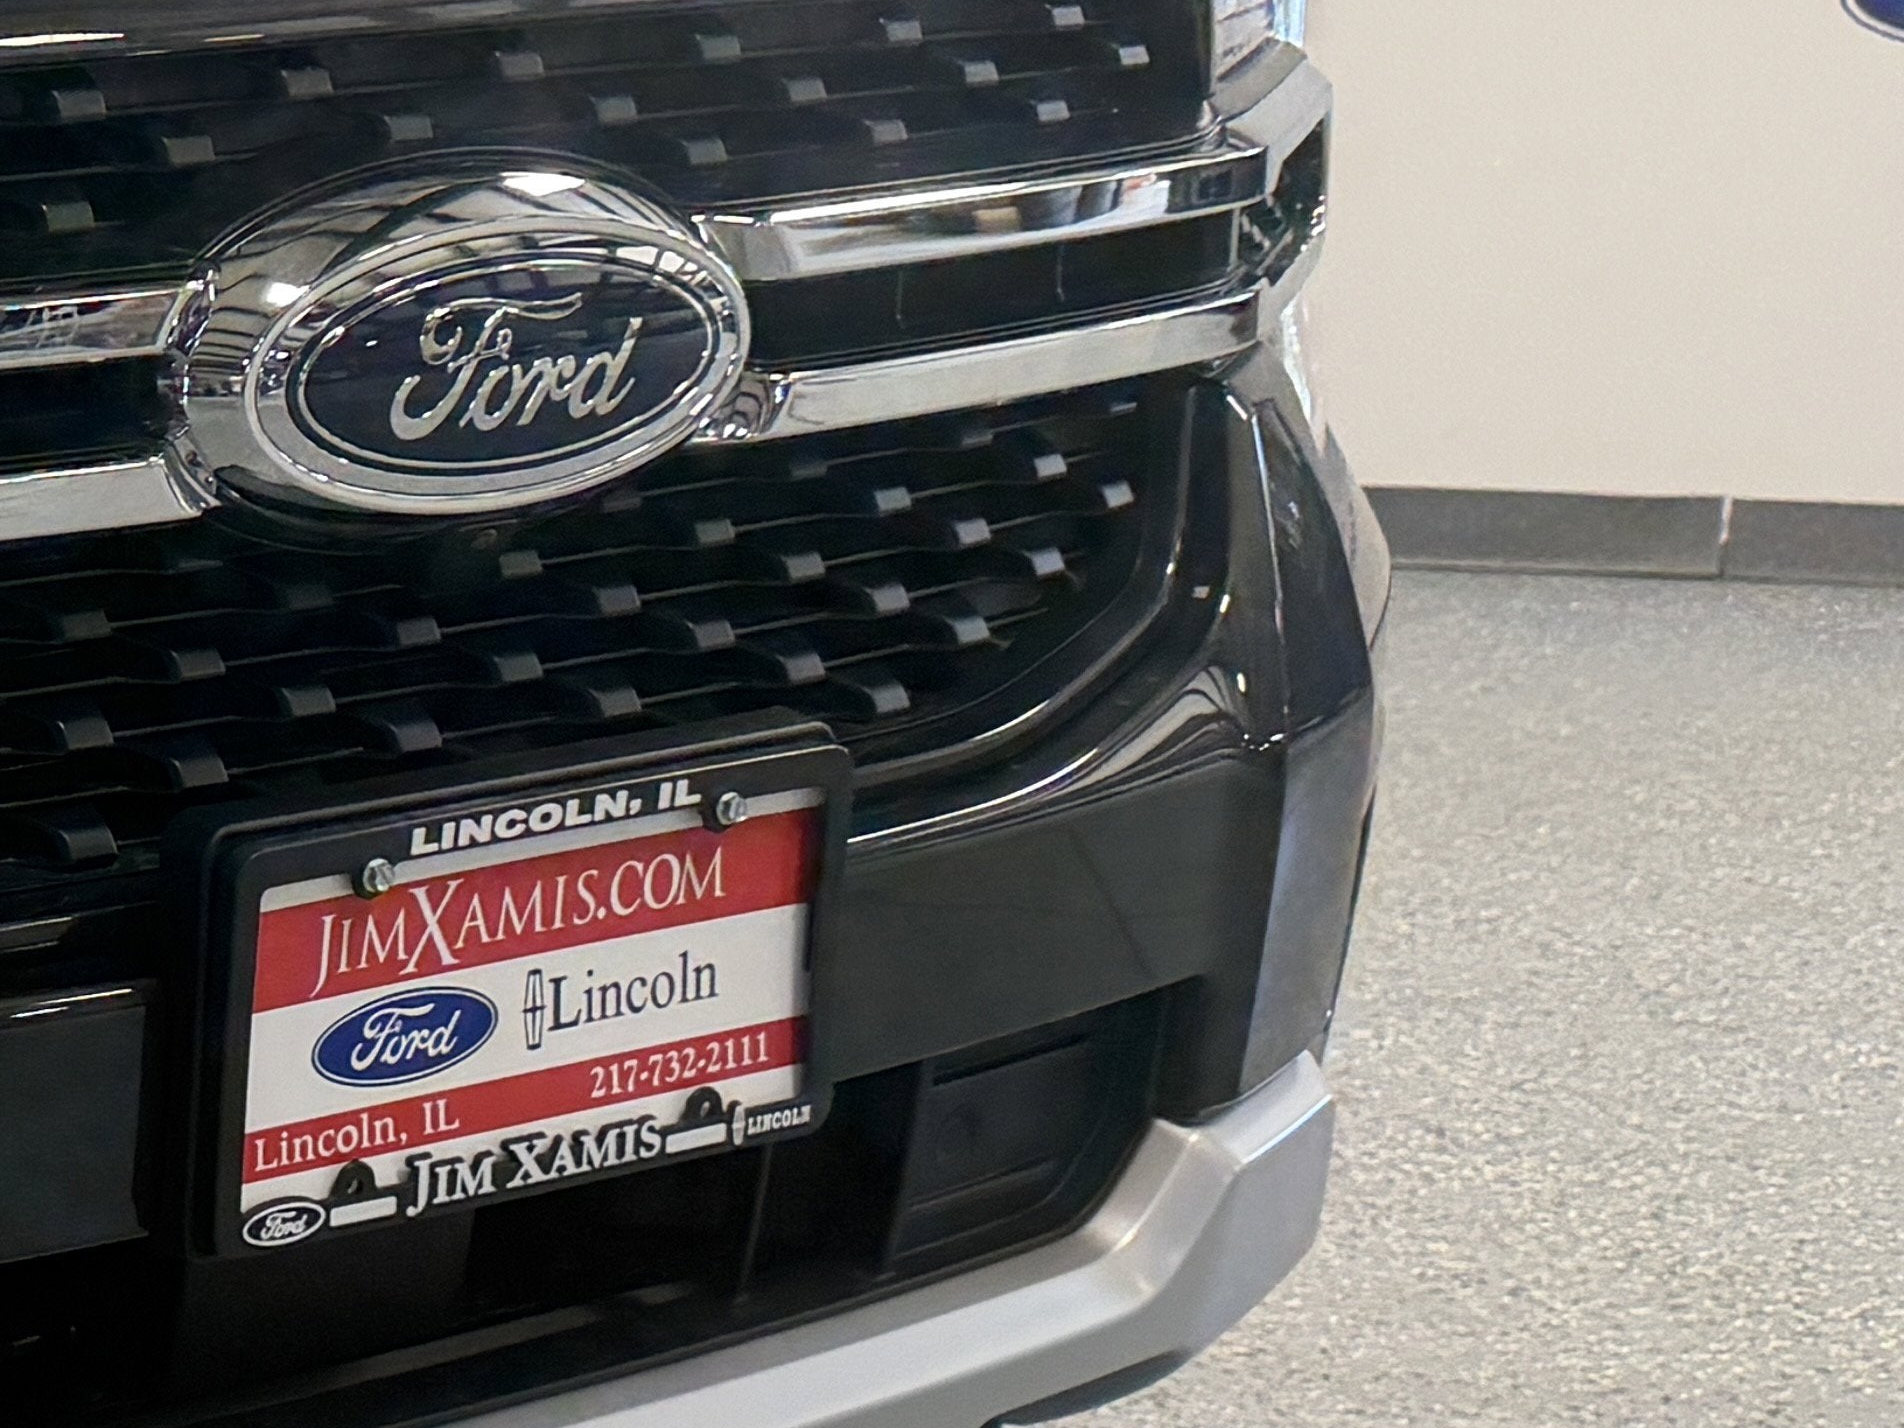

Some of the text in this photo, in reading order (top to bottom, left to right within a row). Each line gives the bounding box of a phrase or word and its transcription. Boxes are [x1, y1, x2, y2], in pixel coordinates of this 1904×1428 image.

[391, 291, 644, 442] Ford
[409, 778, 703, 857] LINCOLN, IL
[546, 951, 719, 1033] Lincoln
[349, 1006, 458, 1072] Ford
[589, 1031, 770, 1099] 217-732-2111
[253, 1098, 461, 1173] Lincoln, IL
[259, 1103, 812, 1241] Ford JIM XAMIS LINCOLN
